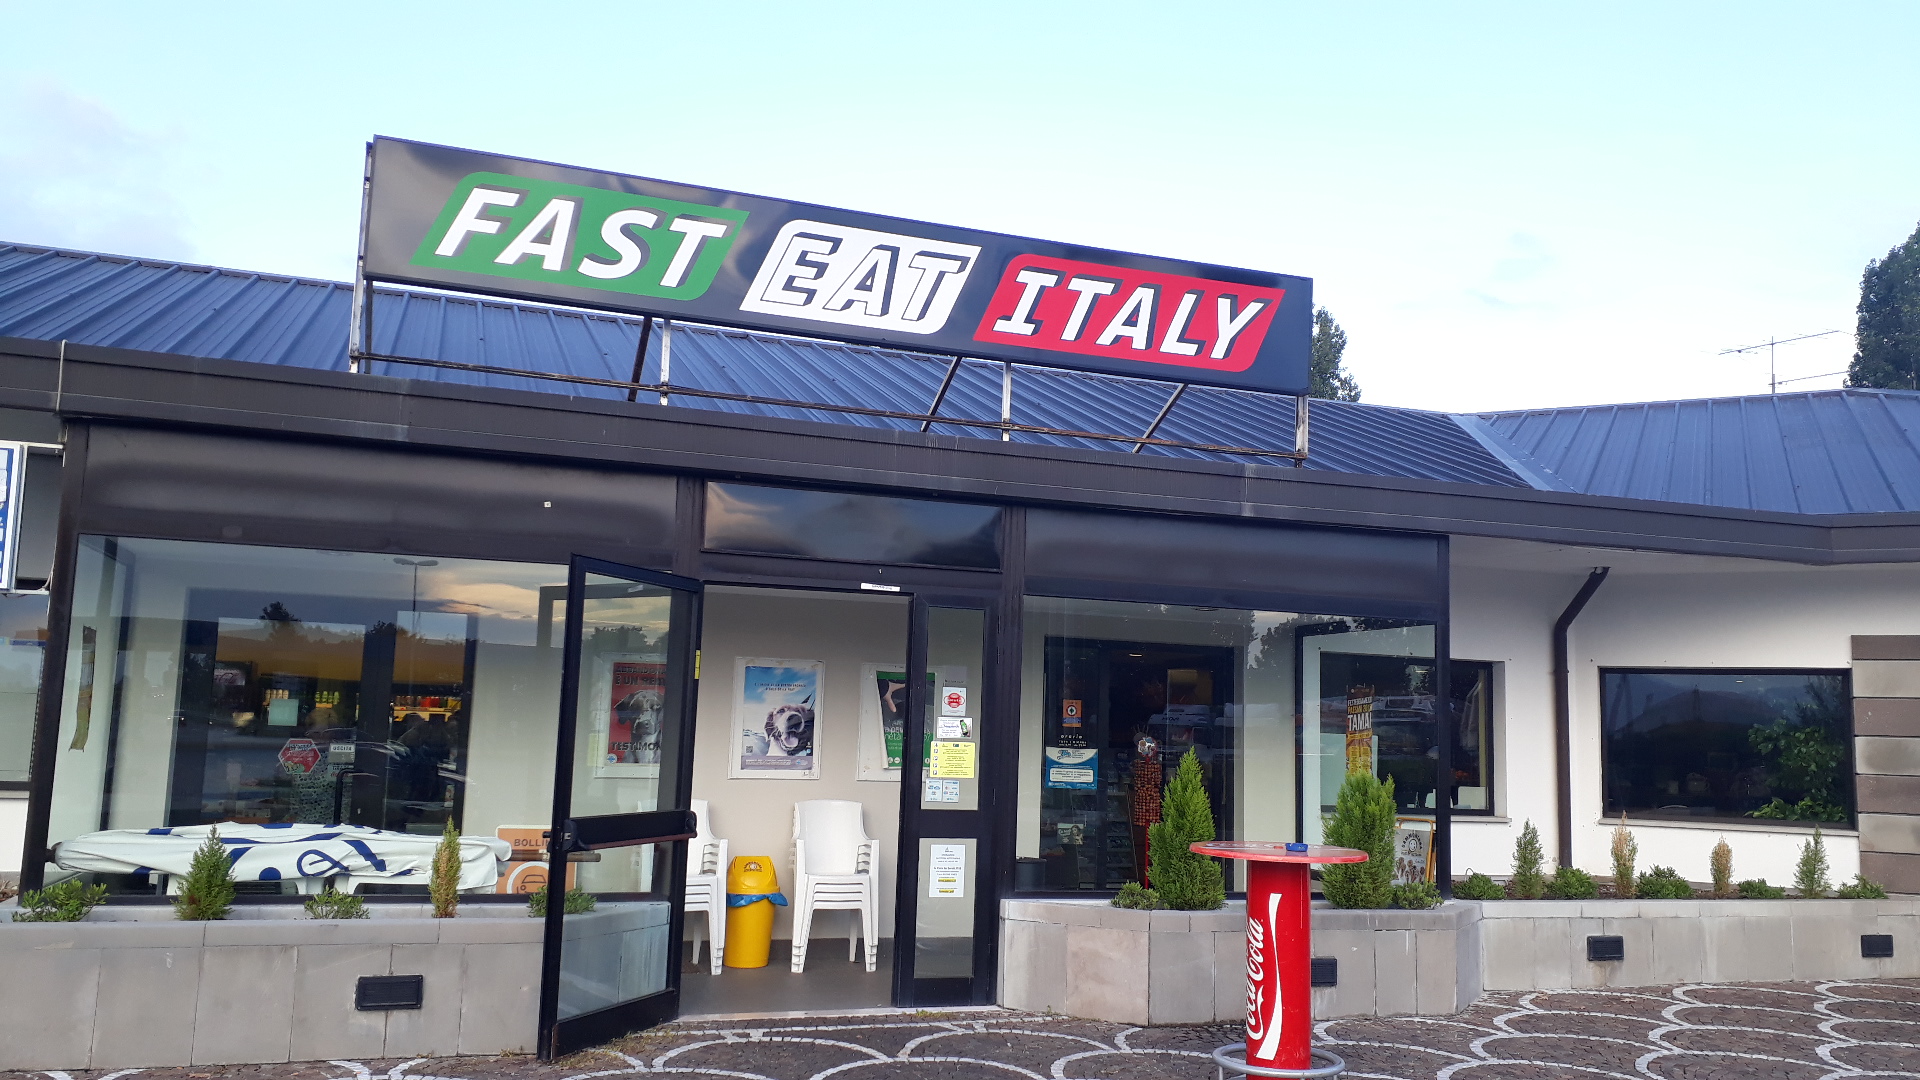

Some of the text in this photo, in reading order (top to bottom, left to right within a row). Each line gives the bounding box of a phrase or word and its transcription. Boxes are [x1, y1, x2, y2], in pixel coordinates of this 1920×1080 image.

[434, 183, 1271, 360] FAST EAT ITALY
[1347, 711, 1373, 732] TAMAI
